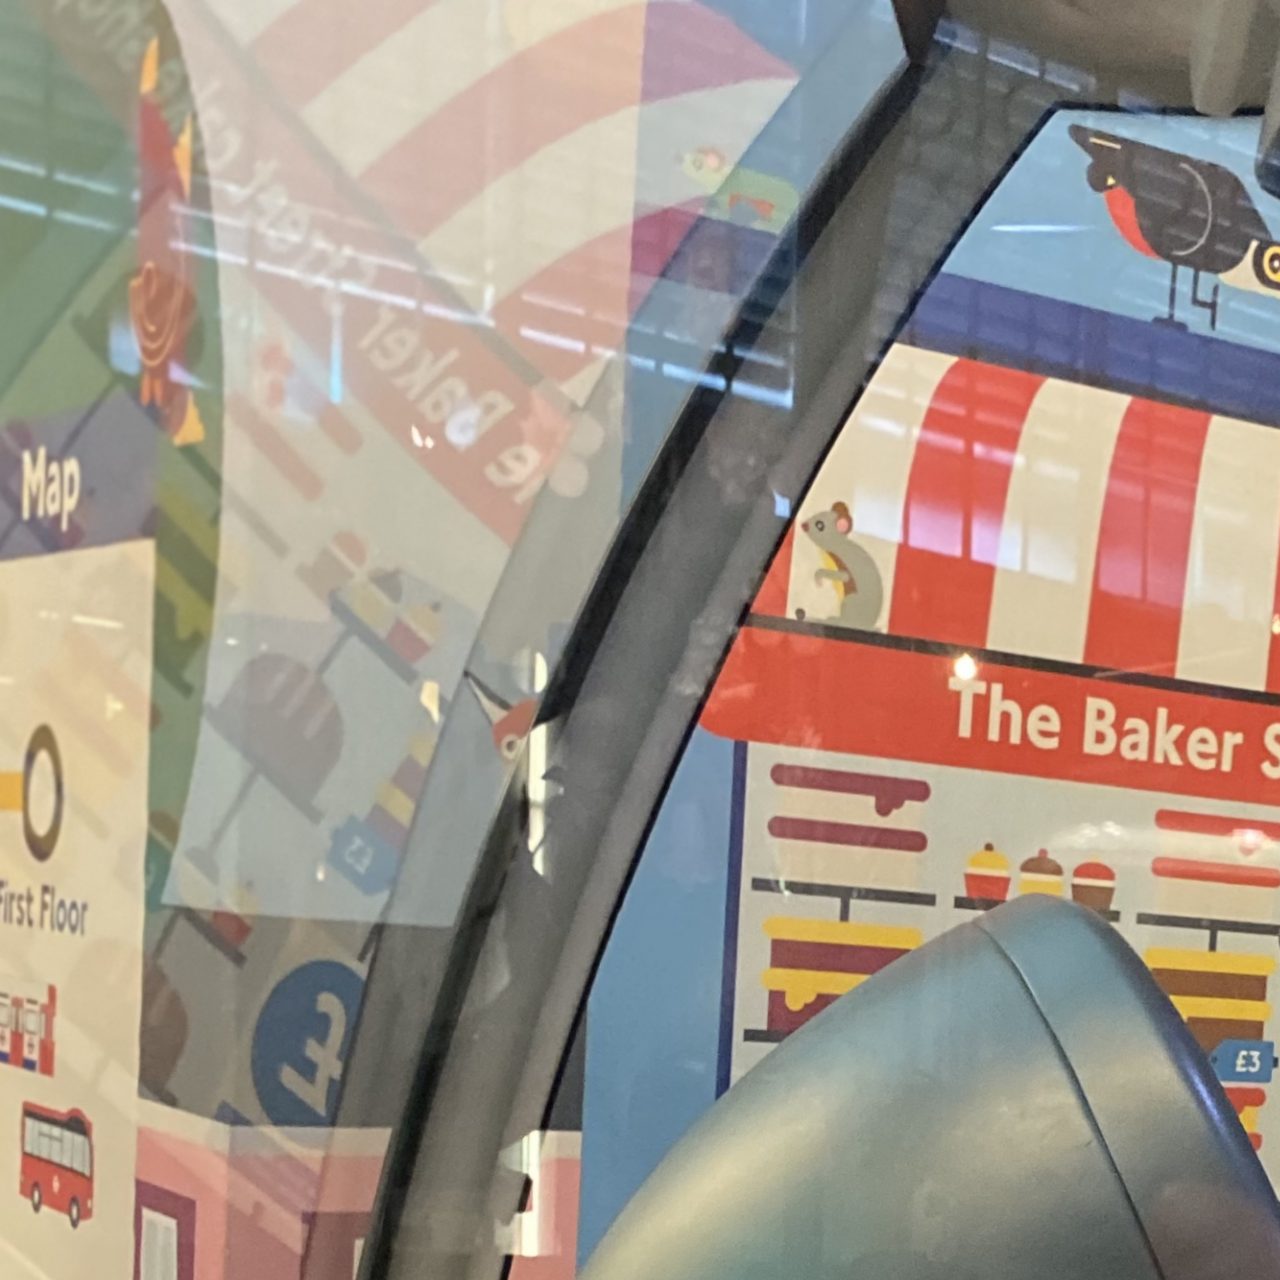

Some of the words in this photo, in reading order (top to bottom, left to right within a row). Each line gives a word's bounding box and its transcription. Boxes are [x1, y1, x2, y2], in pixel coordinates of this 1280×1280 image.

[22, 445, 81, 533] Map
[948, 674, 1061, 750] The
[1083, 695, 1244, 772] Baker
[39, 884, 88, 935] Floor
[1235, 1049, 1261, 1073] £3
